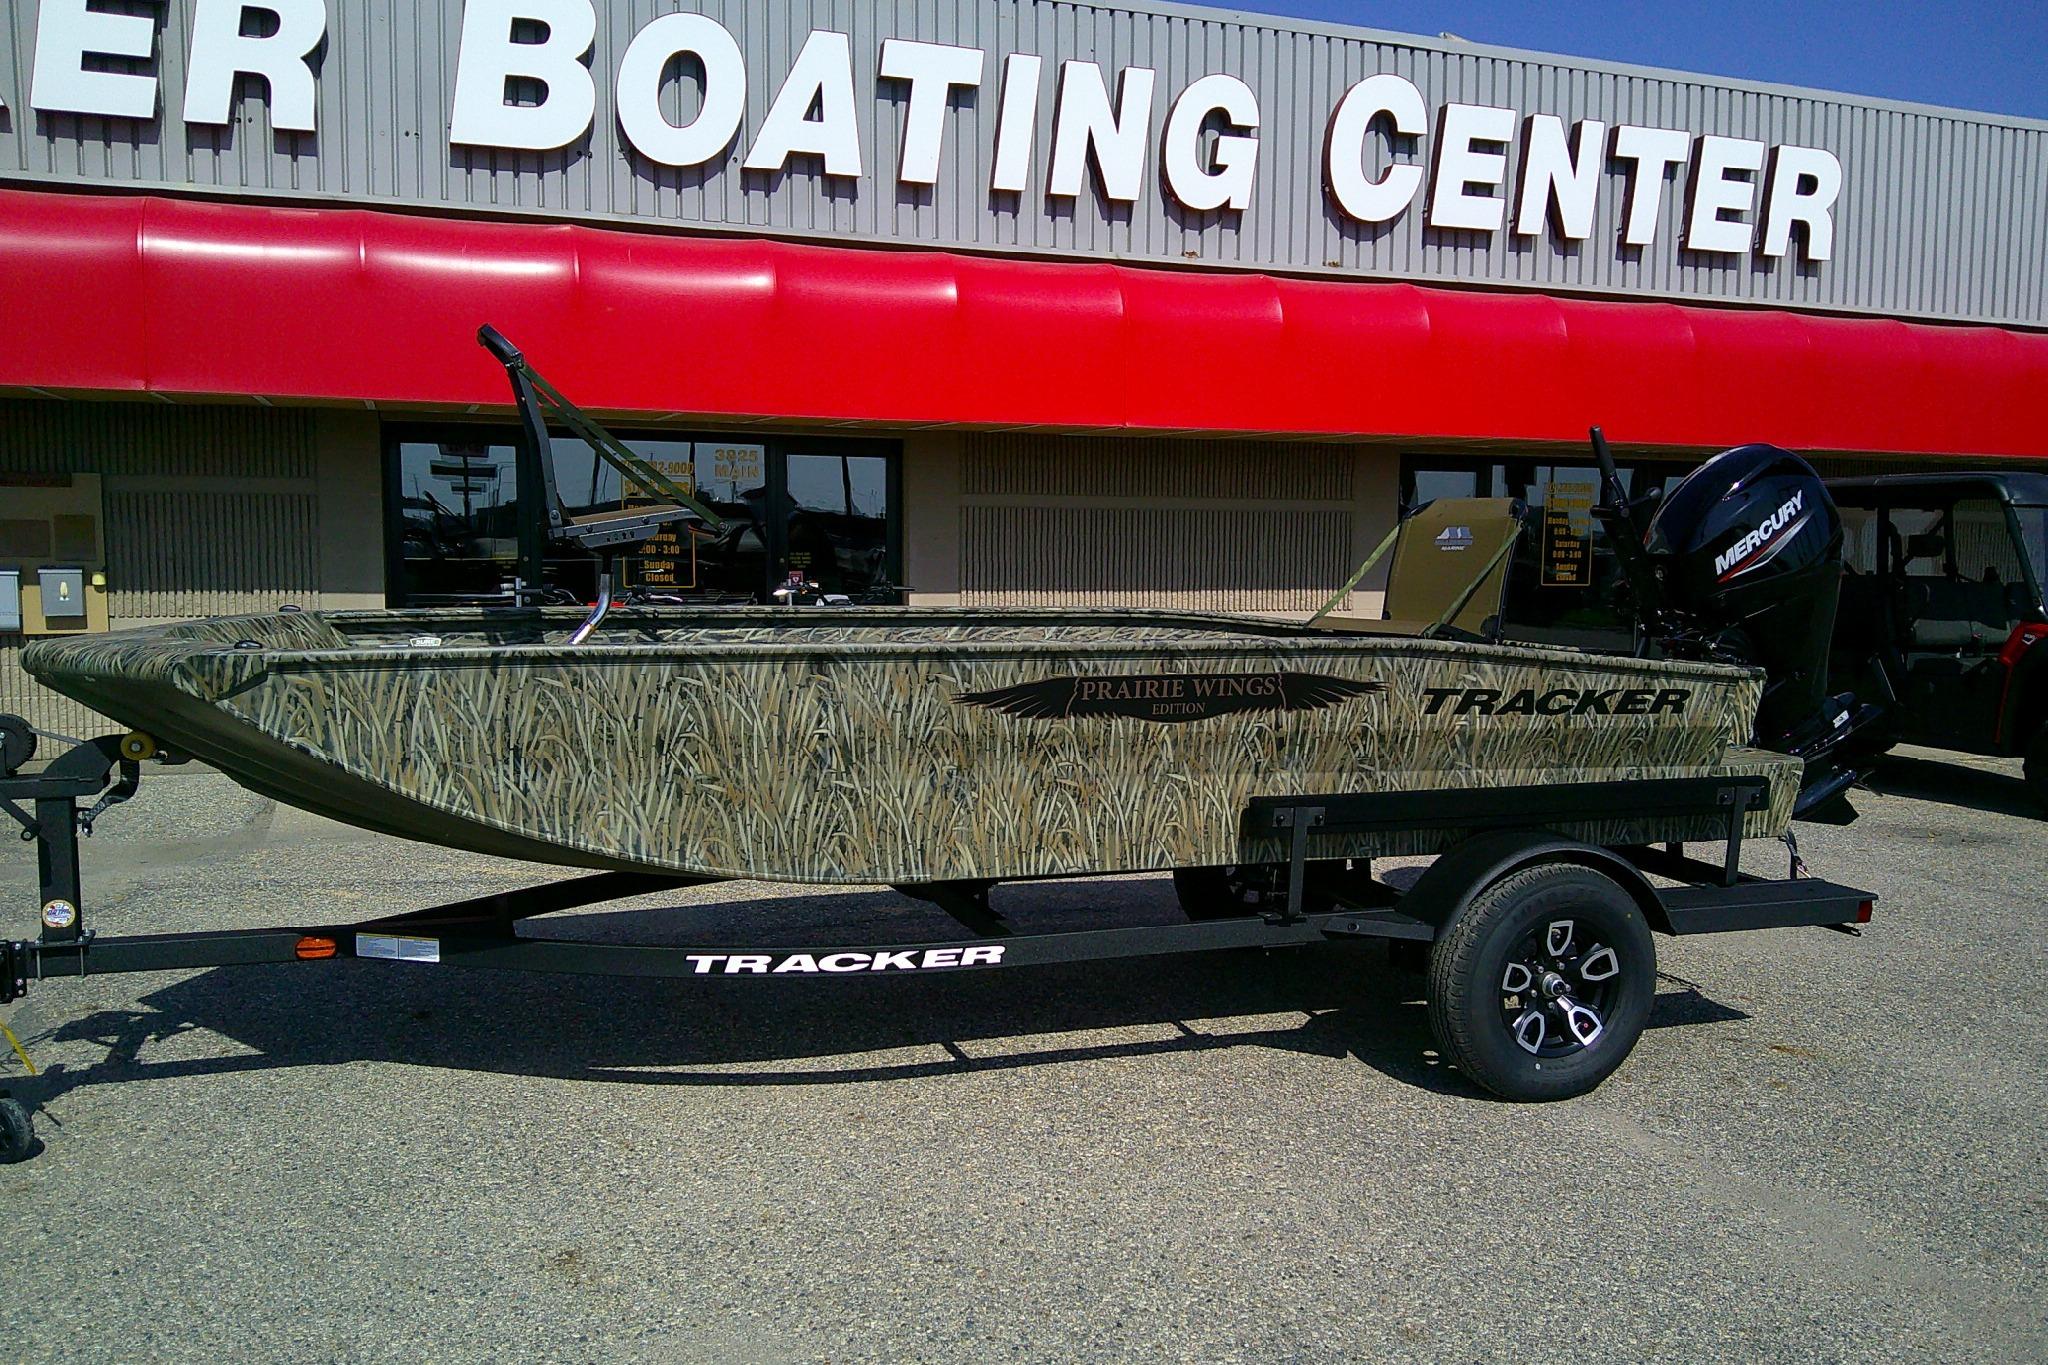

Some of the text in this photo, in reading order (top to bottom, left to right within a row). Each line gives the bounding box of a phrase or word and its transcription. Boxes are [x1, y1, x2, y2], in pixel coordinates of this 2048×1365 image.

[0, 0, 1843, 262] ER BOATING CENTER
[714, 463, 760, 479] MAIN
[1714, 488, 1803, 576] MERCURY
[644, 560, 675, 570] Sunday
[645, 572, 675, 582] Closed
[1081, 676, 1276, 700] PRAIRIE WINGS
[1152, 702, 1206, 716] EDITION
[1422, 688, 1691, 716] TRACKER
[685, 945, 1006, 974] TRACKER
